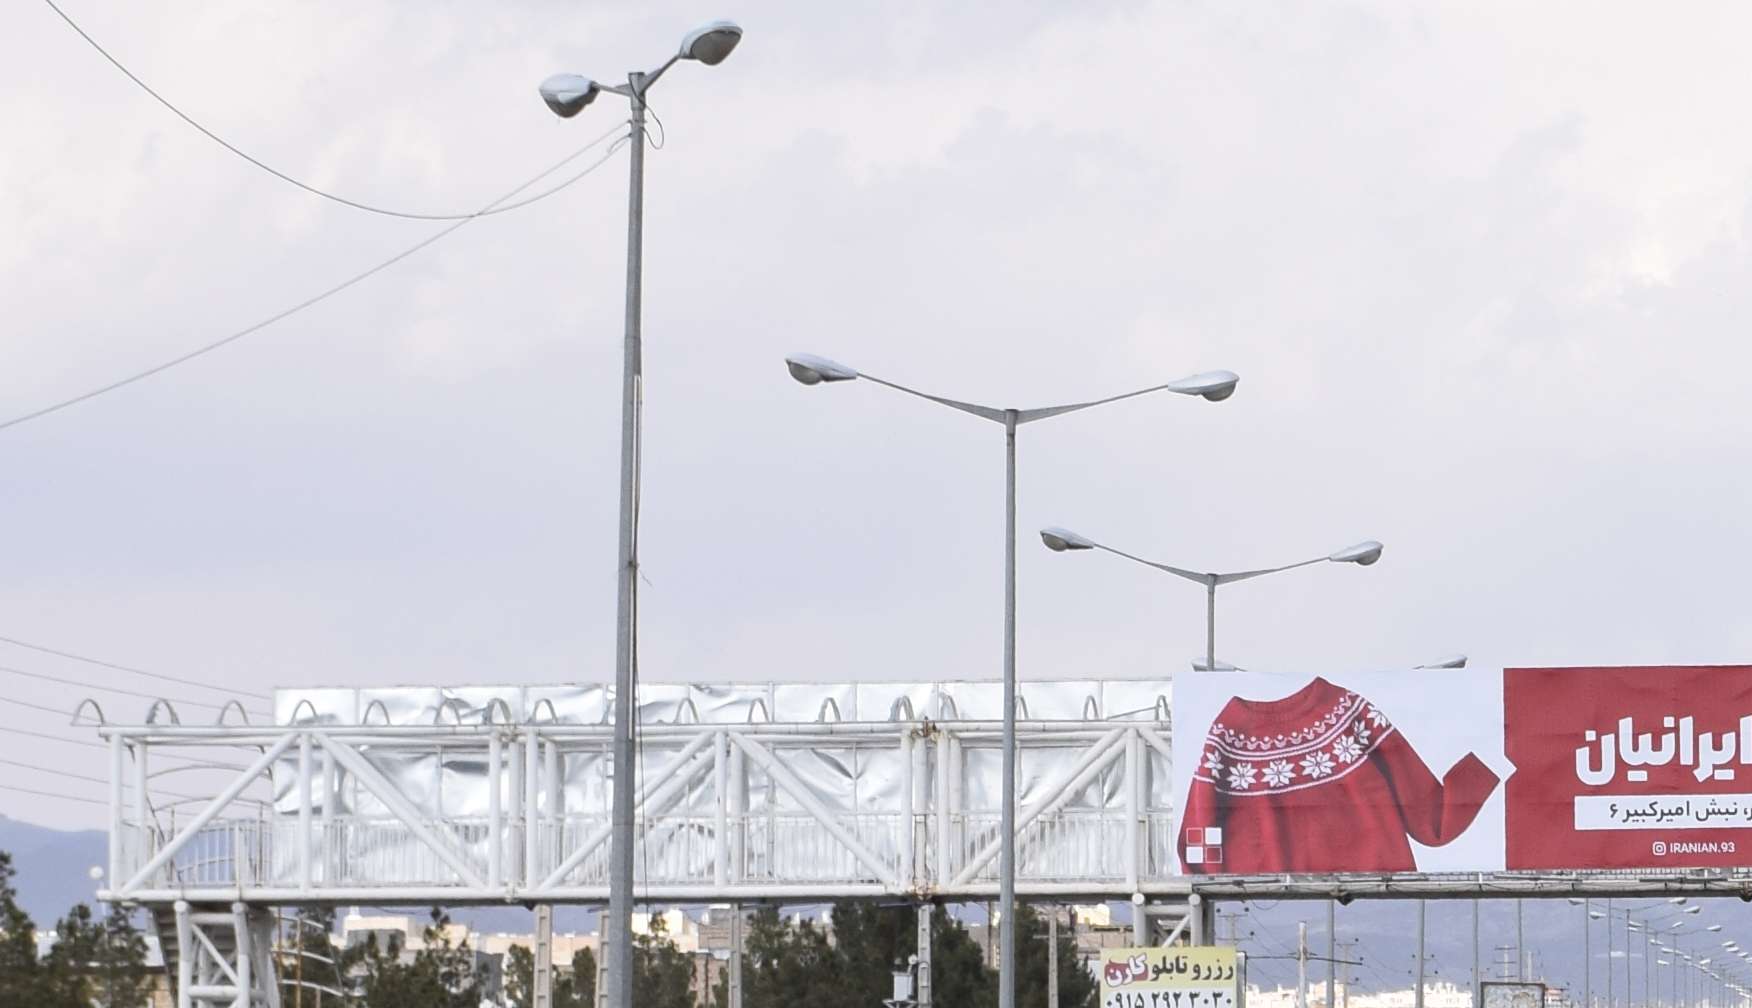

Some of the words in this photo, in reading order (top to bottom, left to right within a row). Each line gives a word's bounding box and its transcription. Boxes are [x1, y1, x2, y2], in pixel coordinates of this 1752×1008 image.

[1621, 800, 1690, 823] امیرکبیر
[1695, 799, 1738, 821] نبش
[1669, 841, 1736, 854] IRANIAN.93
[1150, 955, 1188, 982] تابلو
[1191, 958, 1234, 981] رزرو
